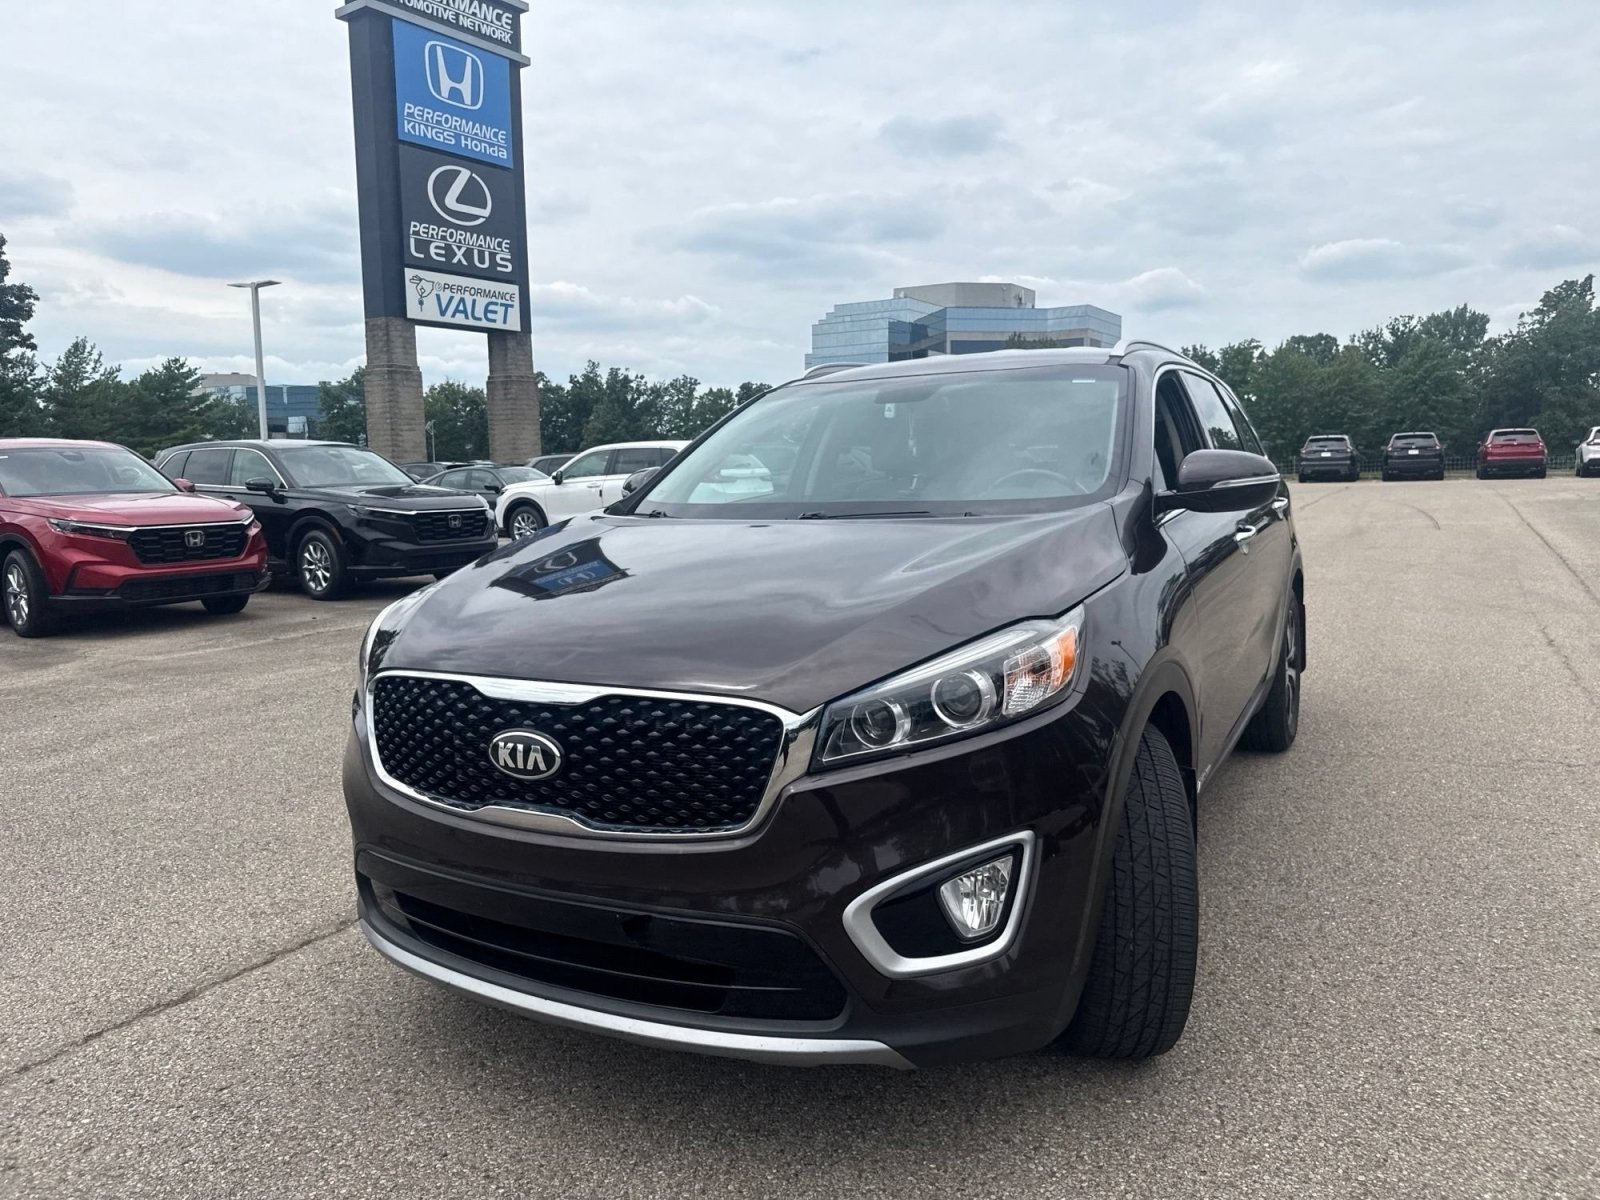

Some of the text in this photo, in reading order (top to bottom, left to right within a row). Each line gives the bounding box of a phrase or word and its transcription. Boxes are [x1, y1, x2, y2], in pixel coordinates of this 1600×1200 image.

[439, 0, 513, 30] MANCE
[459, 14, 512, 45] NETWORK
[404, 102, 507, 144] PERFORMANCE
[404, 119, 508, 160] KINGS Honda
[410, 221, 511, 253] PERFORMANCE
[410, 237, 513, 273] LEXUS
[442, 282, 516, 303] PERFORMANCE
[435, 293, 515, 325] VALET
[497, 741, 548, 771] KIA
